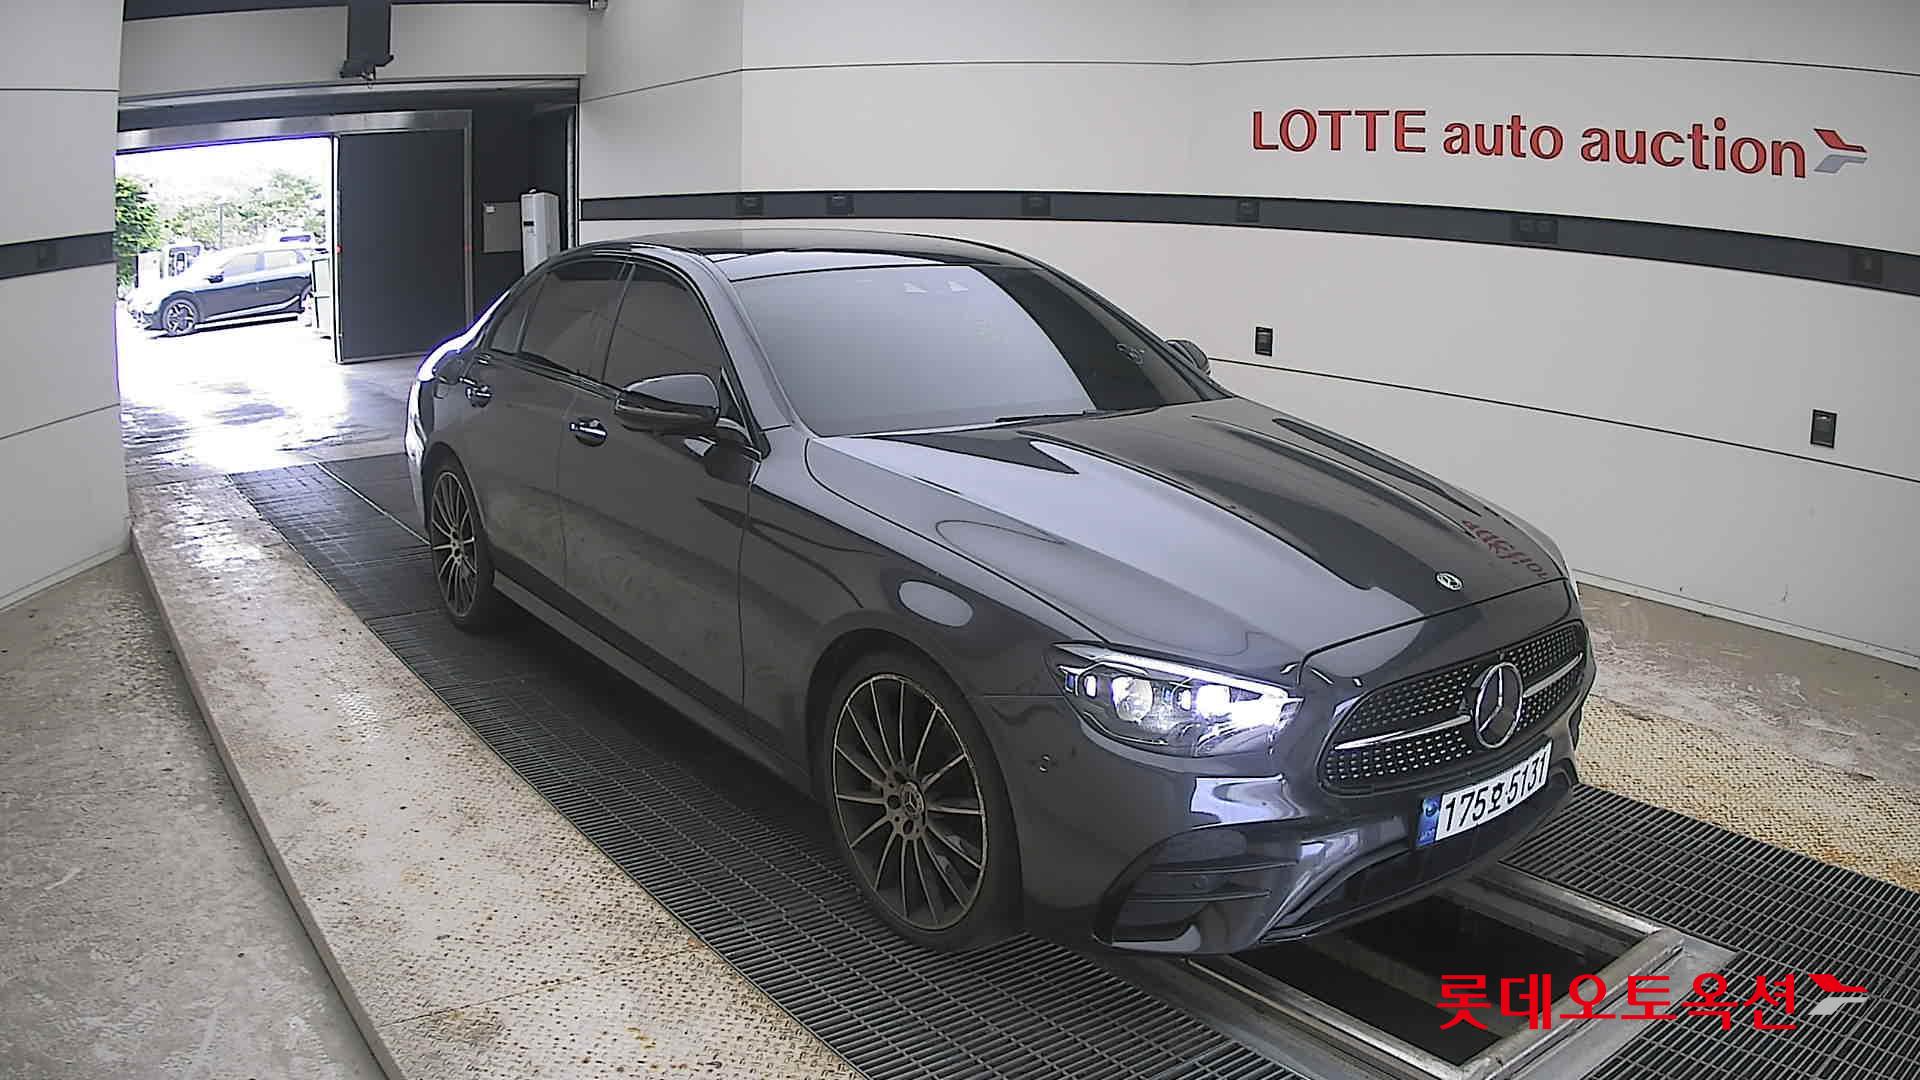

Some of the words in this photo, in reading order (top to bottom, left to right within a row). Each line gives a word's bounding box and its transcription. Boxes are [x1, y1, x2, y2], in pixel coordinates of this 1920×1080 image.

[1253, 110, 1427, 152] LOTTE
[1443, 115, 1565, 159] auto
[1580, 117, 1807, 178] auction
